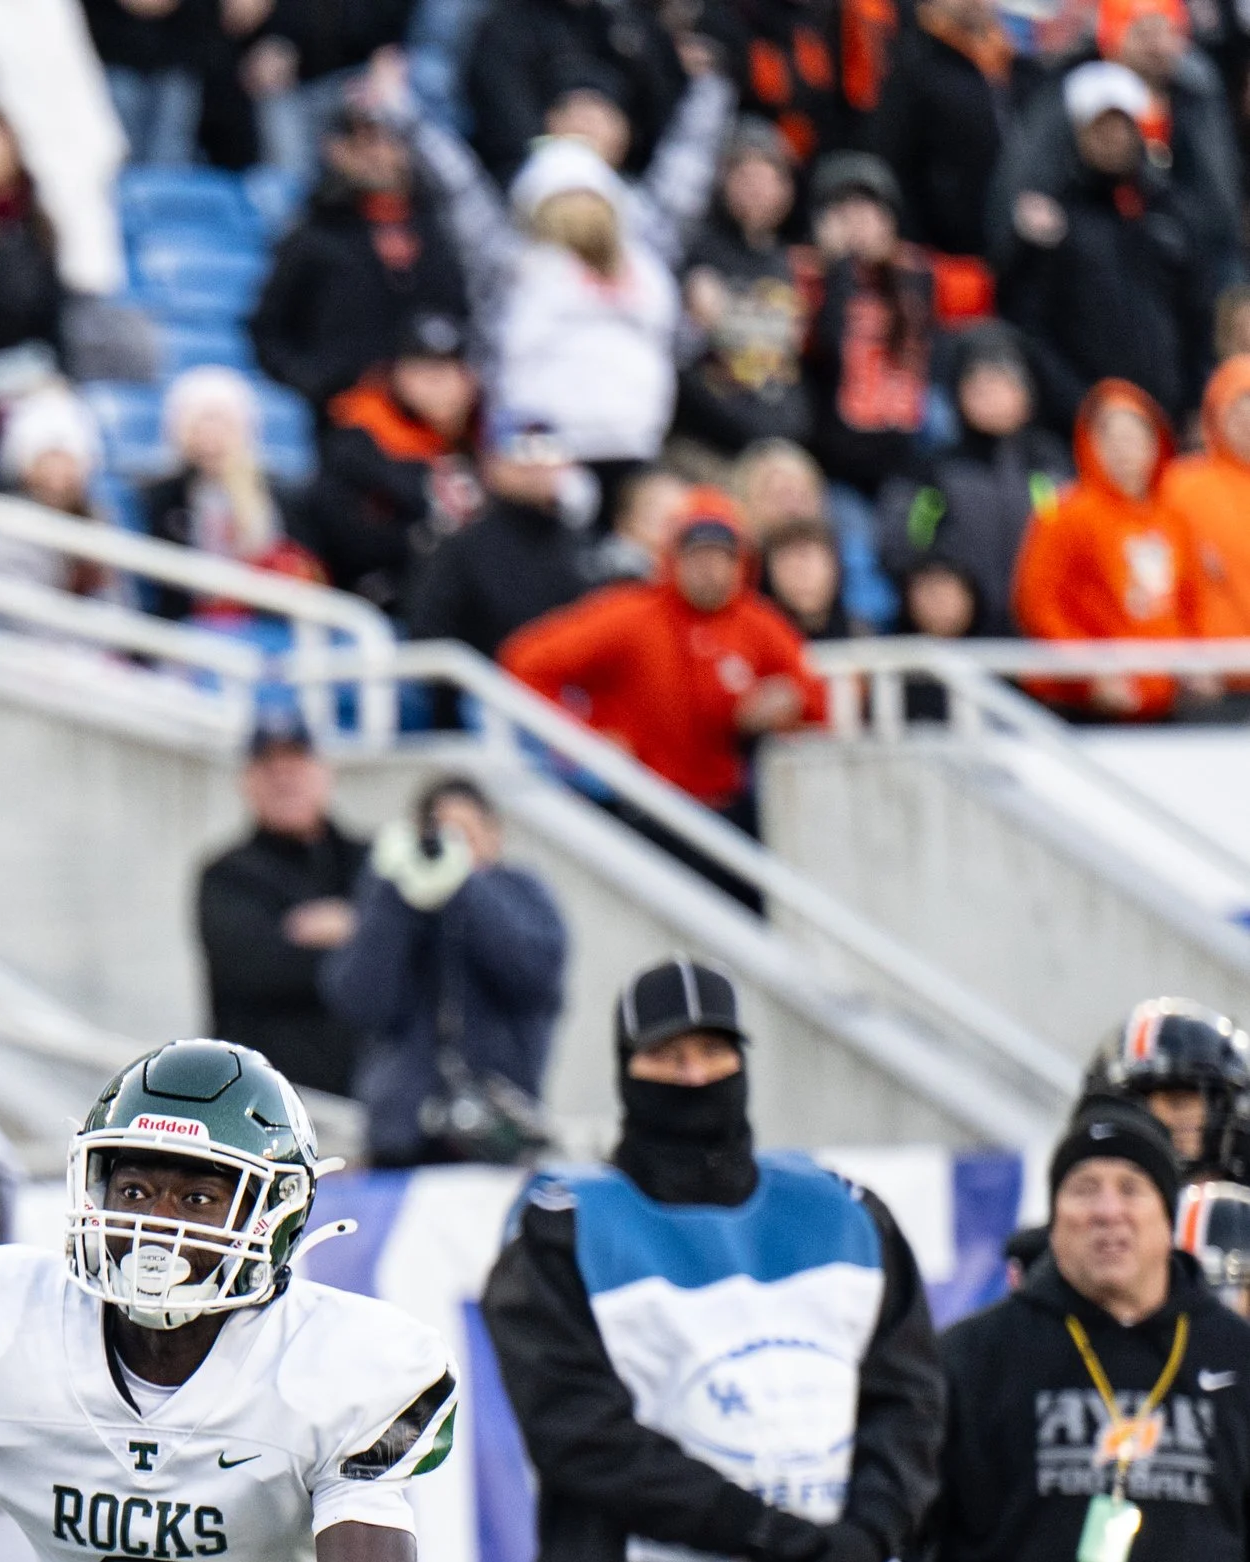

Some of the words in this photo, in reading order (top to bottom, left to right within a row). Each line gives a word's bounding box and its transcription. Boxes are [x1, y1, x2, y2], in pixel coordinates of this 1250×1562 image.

[137, 1116, 200, 1136] Riddell
[128, 1440, 159, 1471] T
[1036, 1466, 1213, 1506] FOOBALL
[52, 1483, 229, 1559] ROCKS
